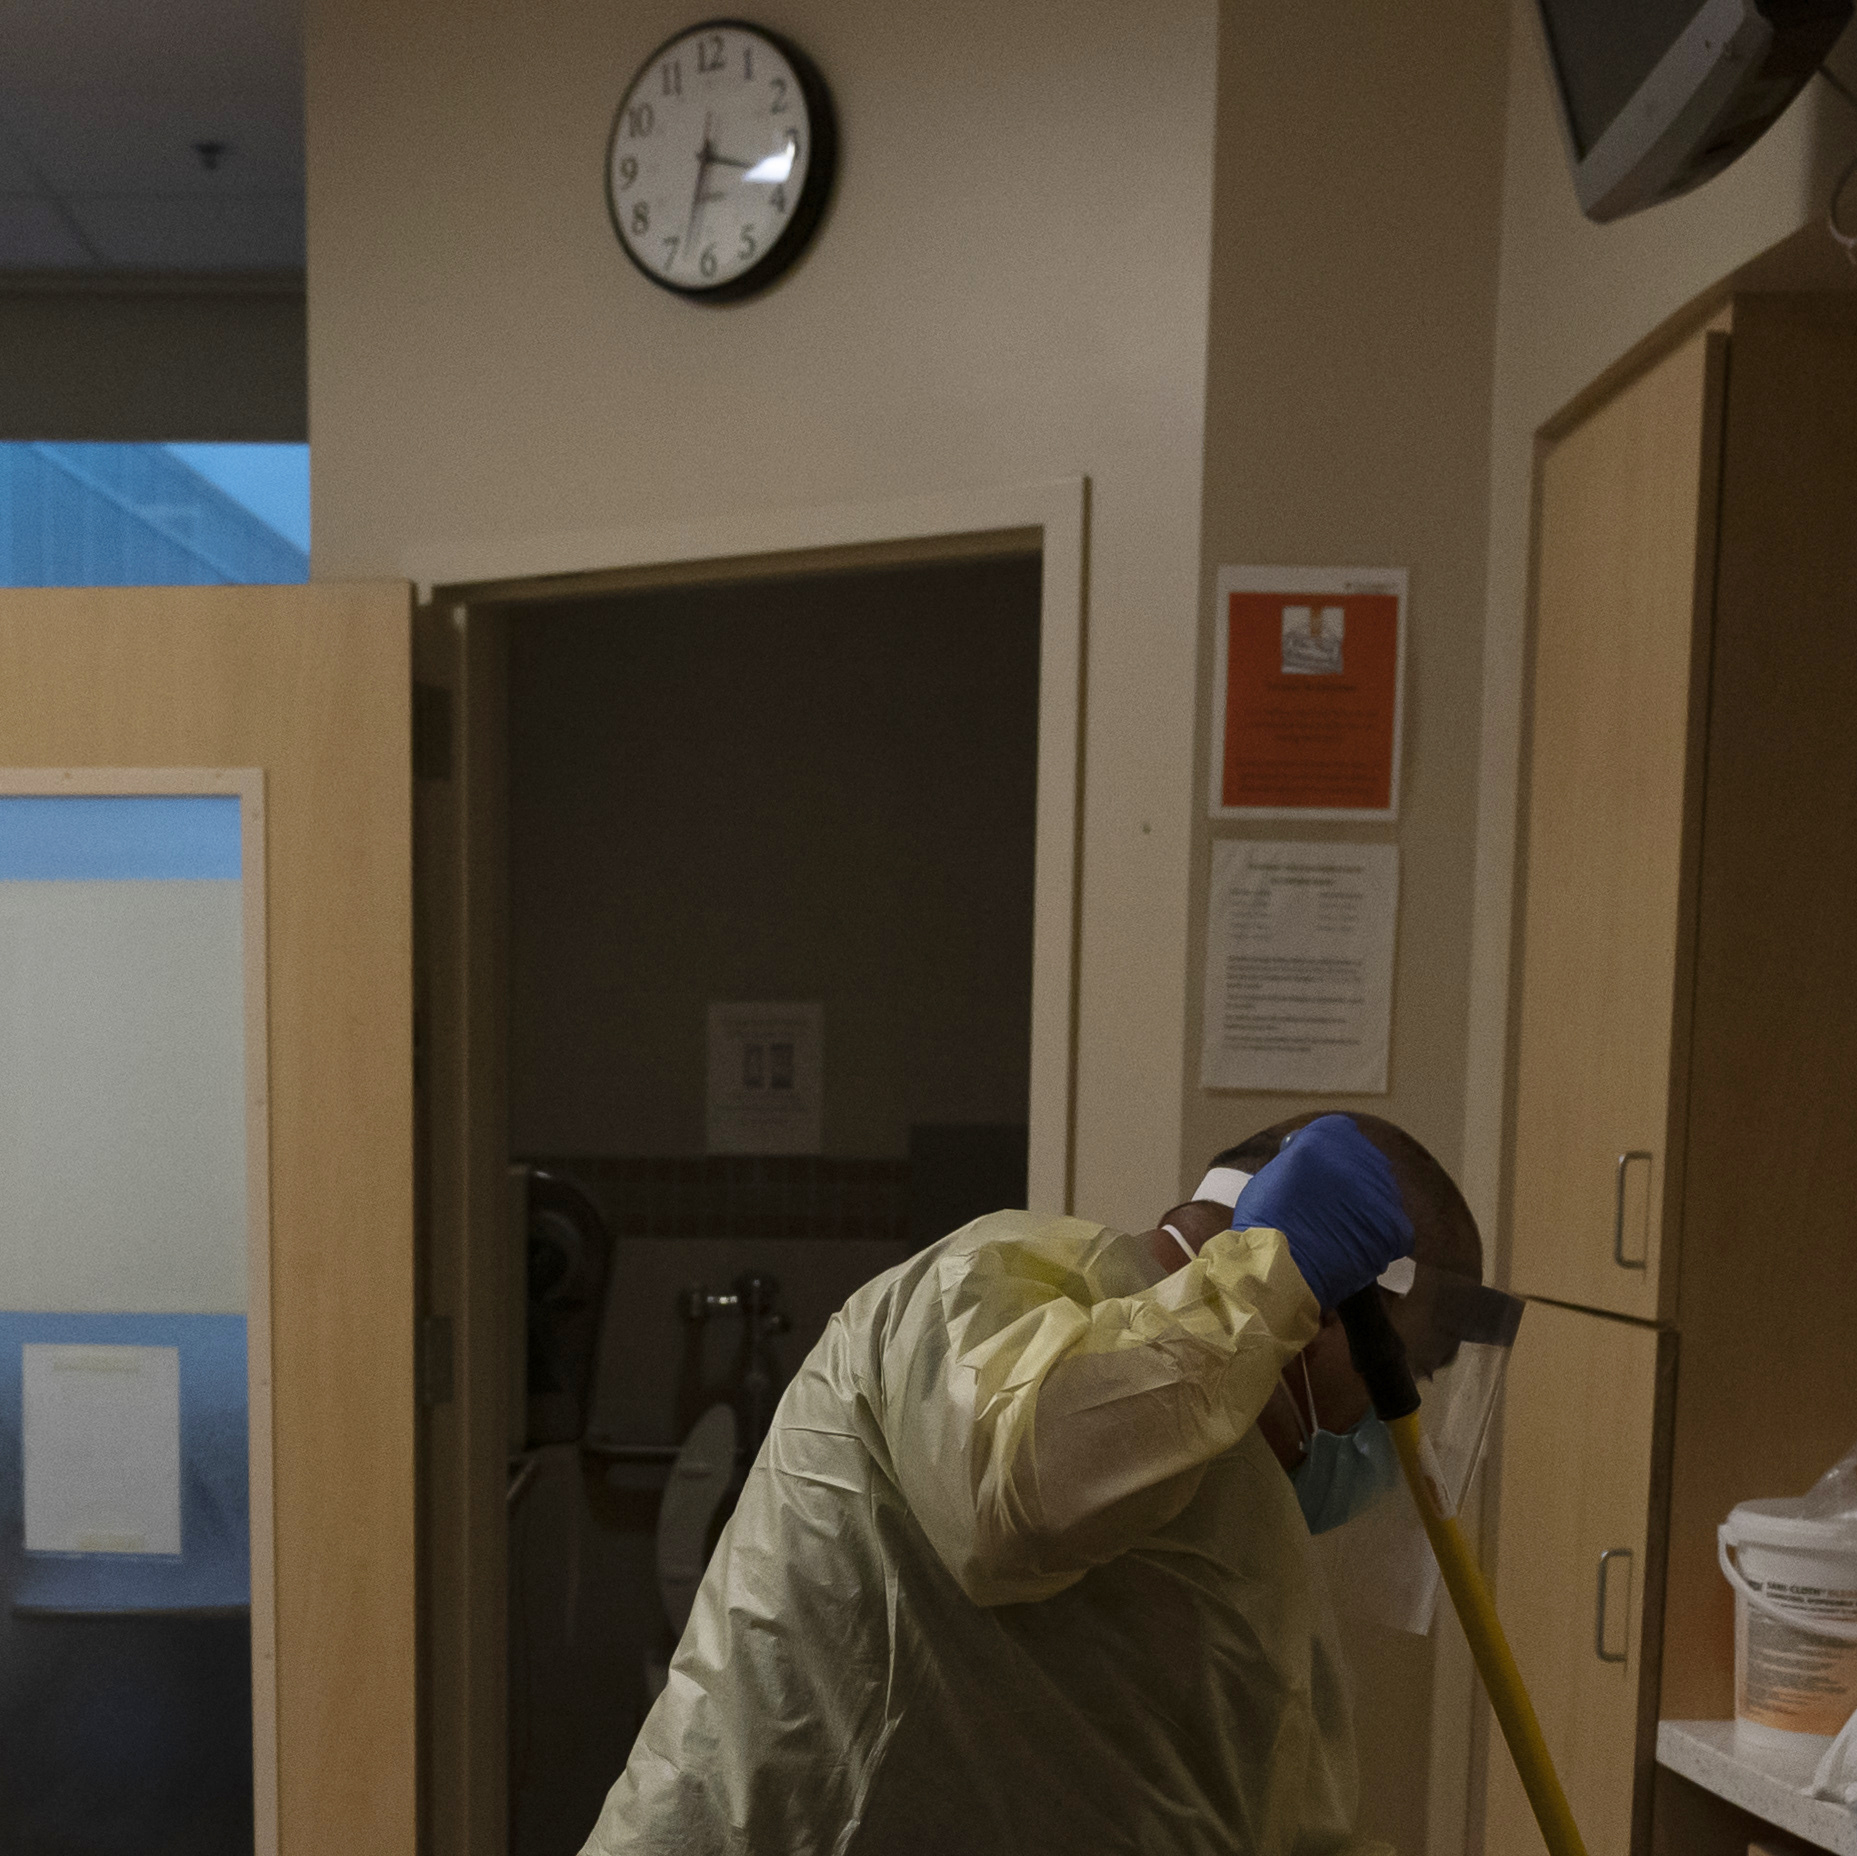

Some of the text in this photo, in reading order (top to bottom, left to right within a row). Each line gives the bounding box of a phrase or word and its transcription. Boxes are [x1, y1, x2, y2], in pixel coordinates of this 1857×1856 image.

[696, 35, 726, 73] 12
[743, 47, 753, 82] 1
[661, 60, 682, 96] 11
[769, 79, 787, 115] 2
[627, 104, 654, 138] 10
[622, 158, 638, 190] 9
[768, 183, 786, 214] 4
[632, 201, 649, 235] 8
[663, 237, 680, 271] 7
[740, 223, 757, 261] 5
[700, 244, 718, 279] 6
